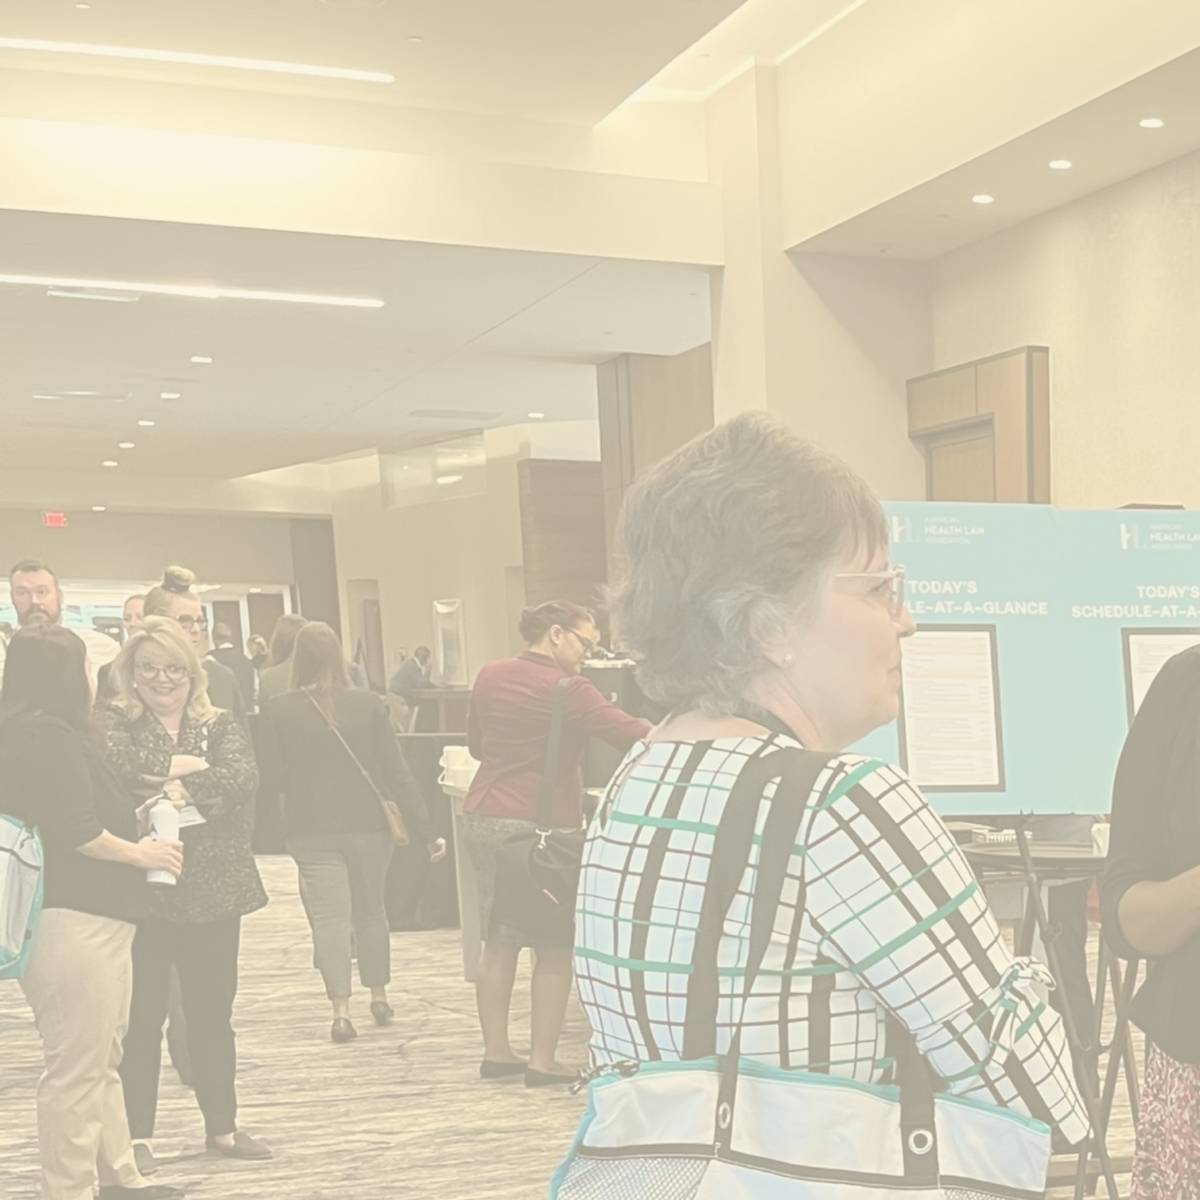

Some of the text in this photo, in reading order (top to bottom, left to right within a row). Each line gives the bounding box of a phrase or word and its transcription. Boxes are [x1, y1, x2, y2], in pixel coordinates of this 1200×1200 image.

[909, 580, 978, 594] TODAY'S
[1136, 585, 1200, 599] TODAY'S
[906, 601, 1049, 615] LE-AT-A-GLANCE
